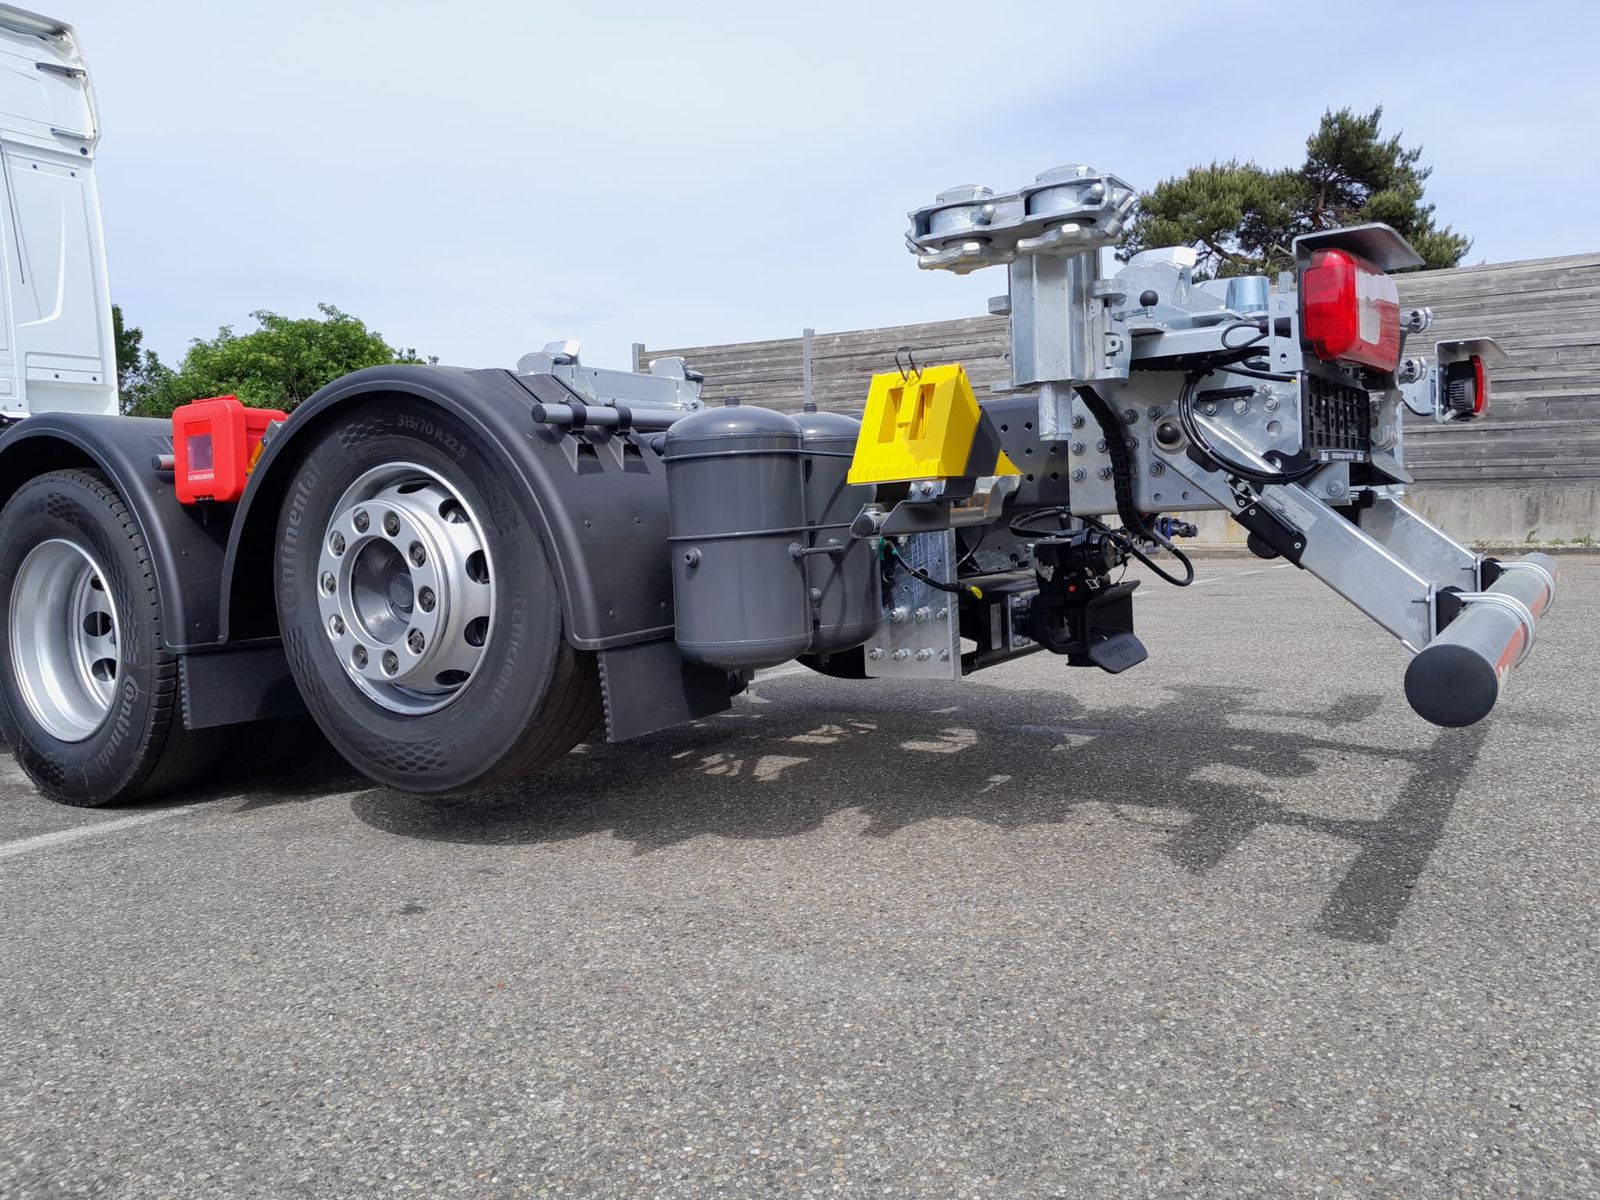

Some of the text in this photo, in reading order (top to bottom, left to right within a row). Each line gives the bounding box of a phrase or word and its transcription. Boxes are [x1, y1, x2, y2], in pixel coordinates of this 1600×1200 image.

[398, 414, 468, 459] 315/70 R 22.5
[281, 457, 320, 615] Continental
